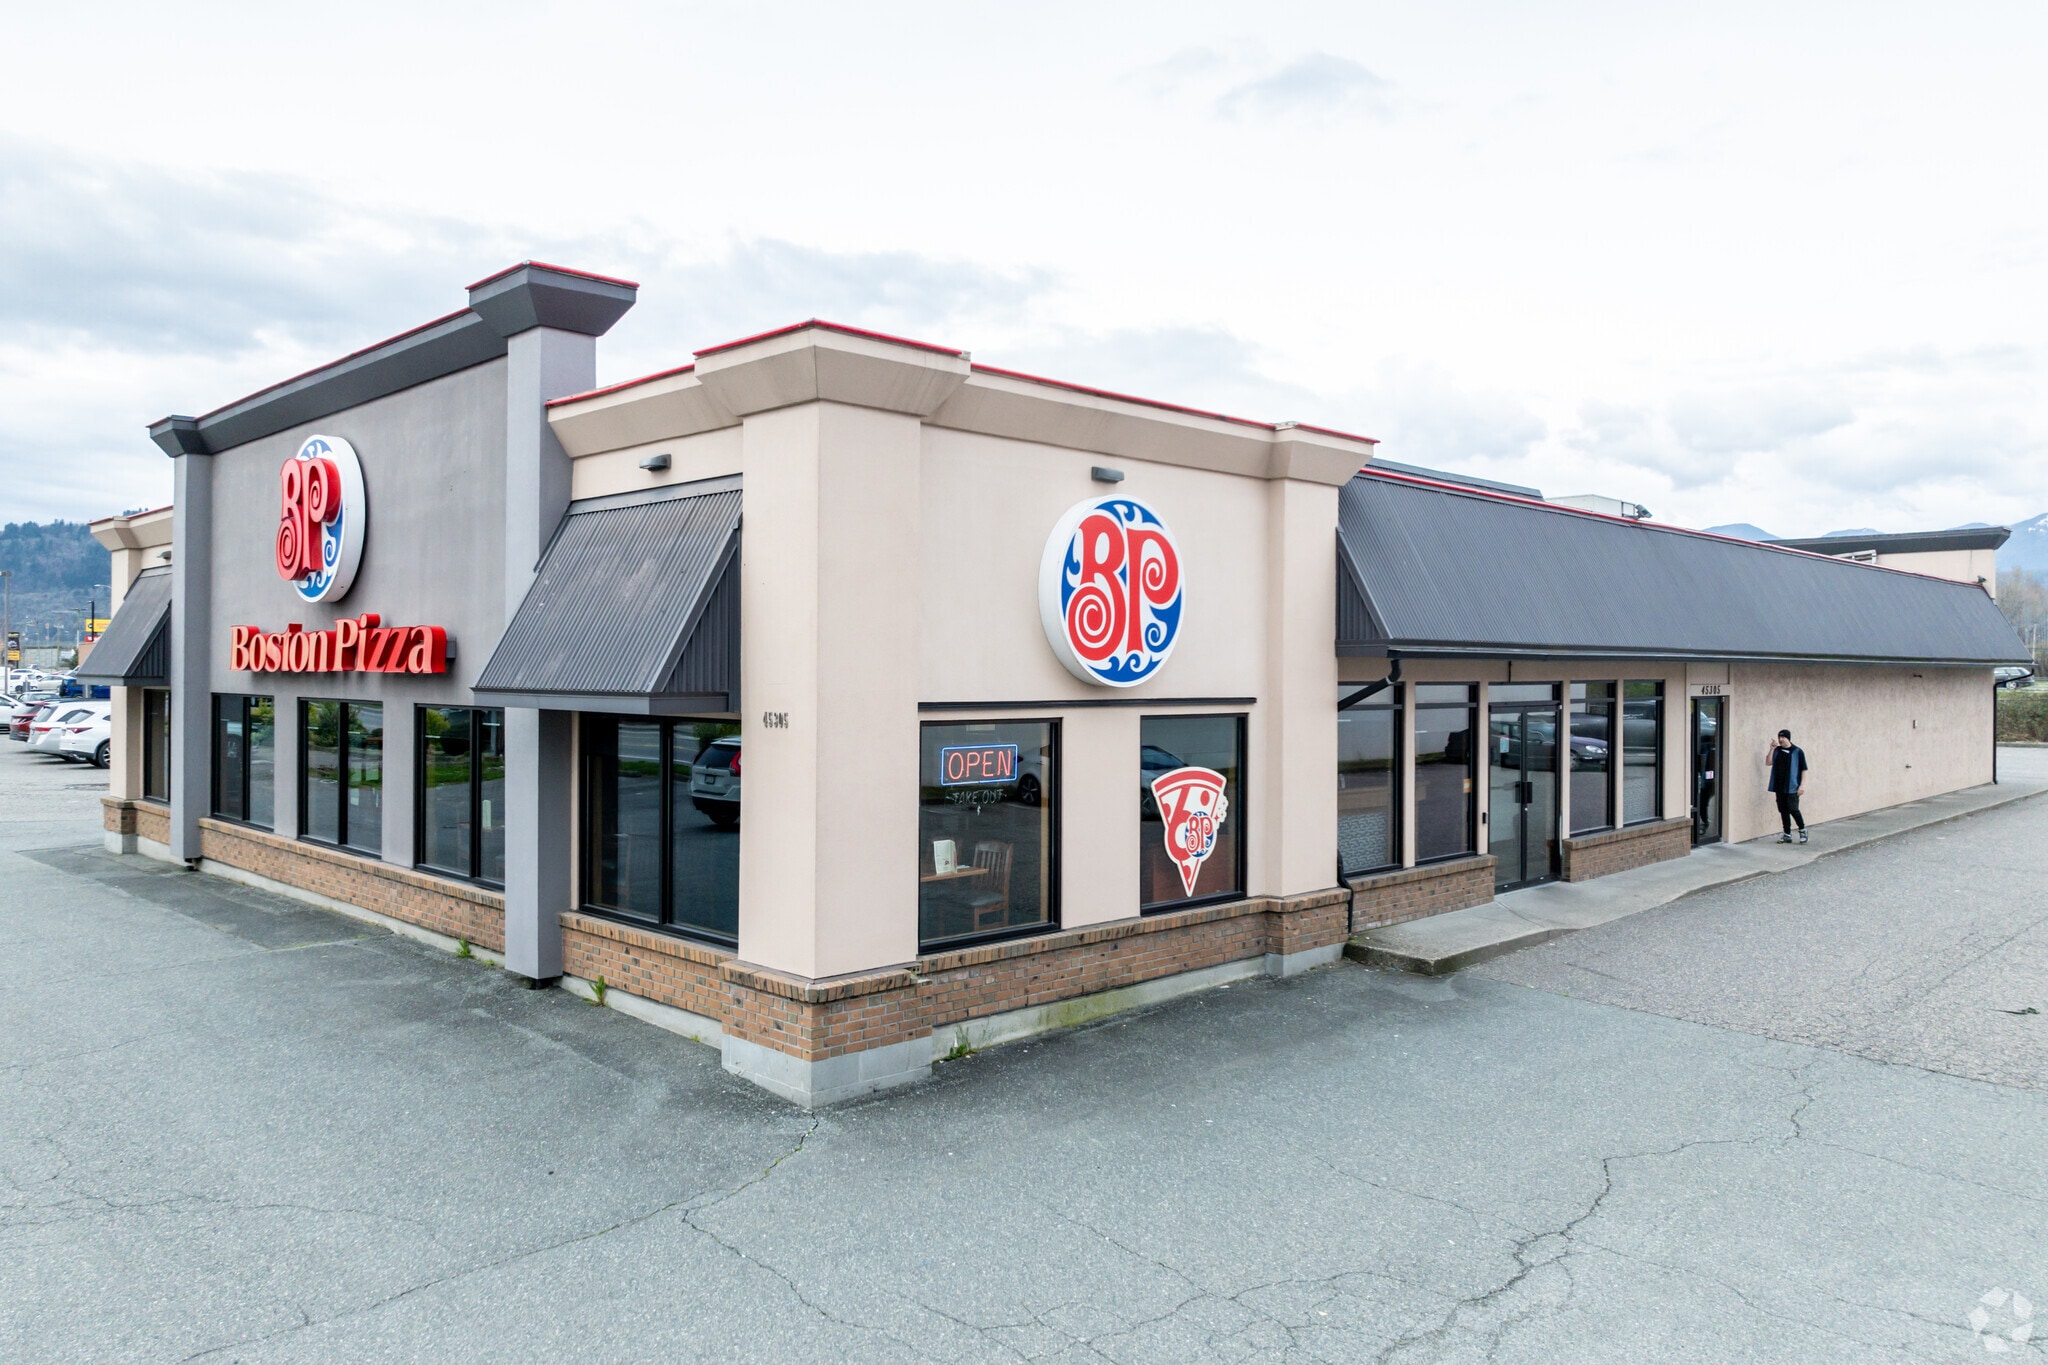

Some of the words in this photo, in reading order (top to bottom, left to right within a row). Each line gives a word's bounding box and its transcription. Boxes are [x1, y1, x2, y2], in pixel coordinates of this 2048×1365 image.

[276, 457, 338, 581] BP
[1068, 514, 1179, 661] BP
[230, 624, 332, 673] Boston
[333, 614, 446, 674] Pizza
[1701, 685, 1721, 695] 45305
[763, 711, 788, 728] 45305
[948, 750, 1011, 779] OPEN
[952, 791, 978, 805] TAKE
[982, 788, 1004, 804] OUT
